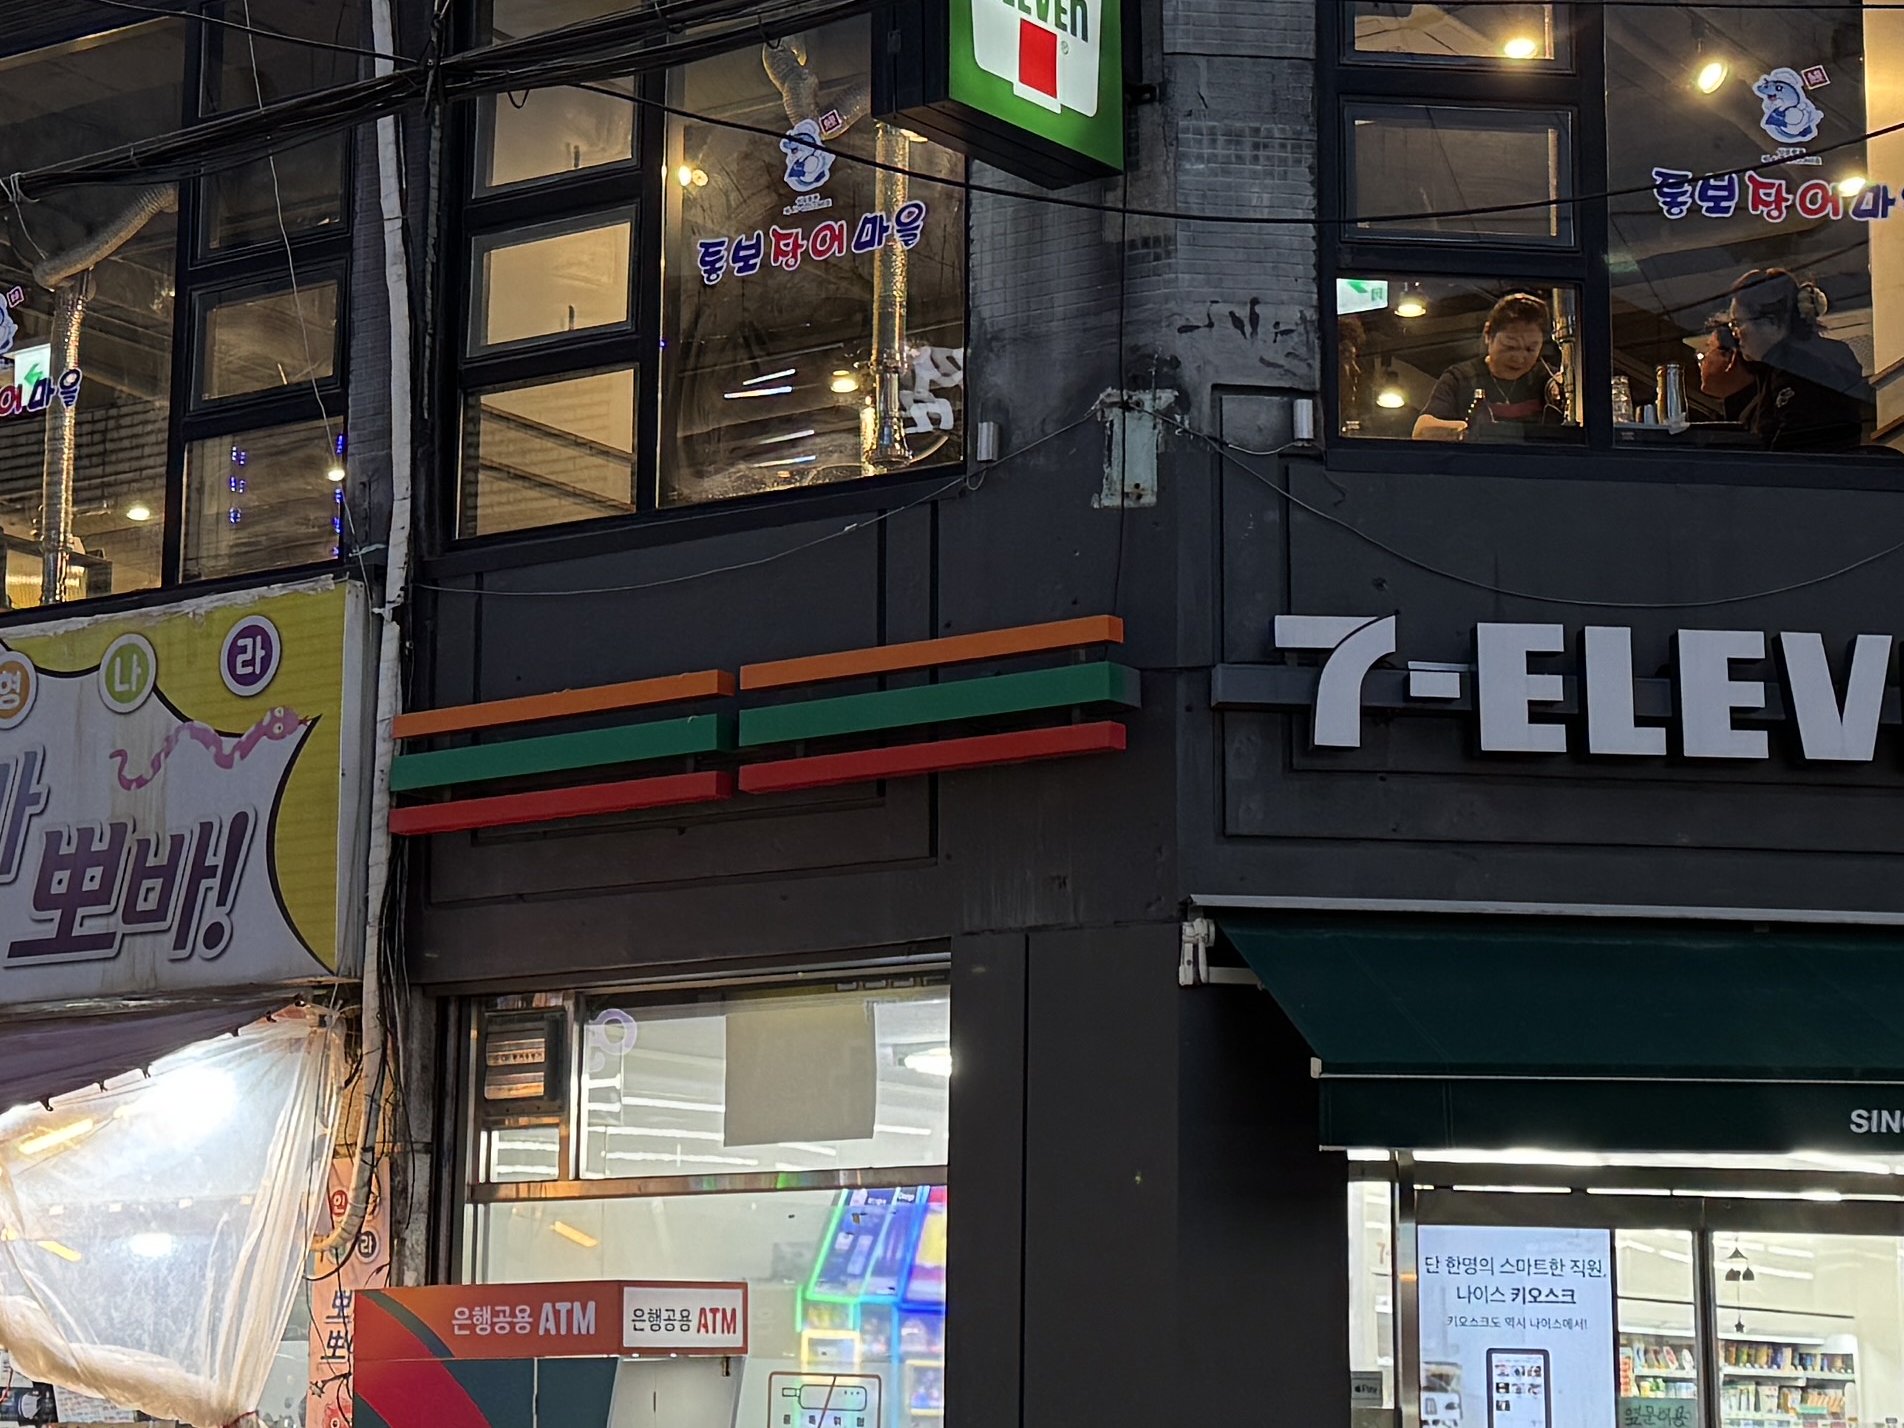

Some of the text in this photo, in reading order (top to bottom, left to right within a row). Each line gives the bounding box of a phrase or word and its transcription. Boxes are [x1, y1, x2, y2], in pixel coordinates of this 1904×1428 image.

[1424, 1255, 1440, 1275] 단
[1444, 1255, 1495, 1276] 한명의
[1498, 1257, 1566, 1278] 스마트한
[1456, 1284, 1577, 1305] 나이스 키오스크
[451, 1301, 596, 1337] 은행공용 ATM
[630, 1306, 738, 1335] 은행공용 ATM
[1447, 1315, 1502, 1328] 키오스크도
